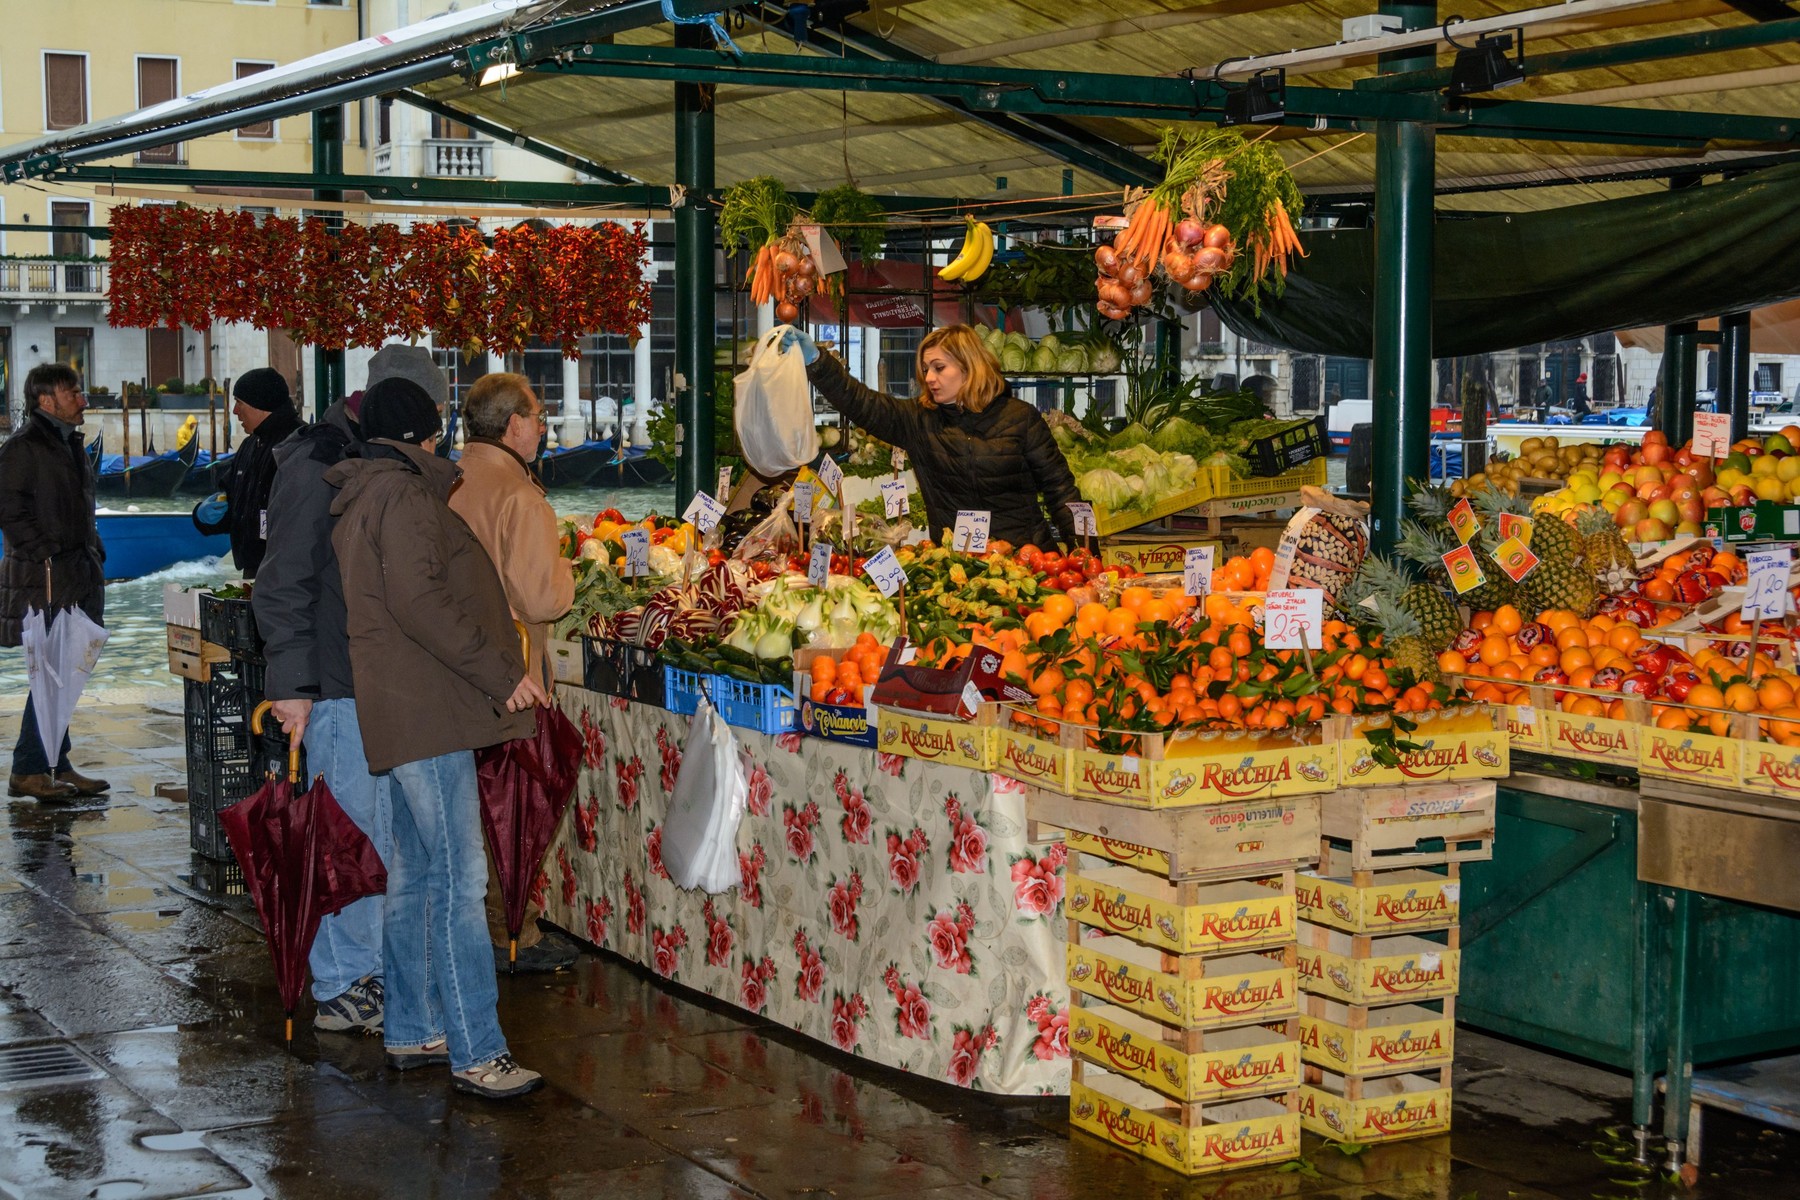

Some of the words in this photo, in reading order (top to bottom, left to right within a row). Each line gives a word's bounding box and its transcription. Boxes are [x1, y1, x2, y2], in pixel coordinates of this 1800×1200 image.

[898, 309, 920, 319] MOSTRA
[1231, 496, 1286, 510] Checchin
[814, 707, 868, 736] Terranova
[900, 721, 955, 758] RECCHIA
[1557, 719, 1628, 753] RECCHIA
[1004, 738, 1057, 776] RECCHIA
[1649, 736, 1725, 773] RECCHIA
[1082, 760, 1141, 794] RECCHIA
[1199, 756, 1292, 796] RECCHIA
[1209, 812, 1245, 826] GROUP
[1246, 807, 1283, 821] MILELLA
[1092, 888, 1153, 932] RECCHIA
[1199, 905, 1282, 941] RECCHIA
[1373, 889, 1447, 922] RECCHIA
[1093, 958, 1154, 1003] RECCHIA
[1370, 959, 1445, 993] RECCHIA
[1202, 977, 1284, 1014] RECCHIA
[1095, 1023, 1157, 1072] RECCHIA
[1367, 1028, 1441, 1063] RECCHIA
[1203, 1051, 1286, 1088] RECCHIA
[1096, 1098, 1157, 1146] RECCHIA
[1362, 1098, 1437, 1134] RECCHIA
[1202, 1123, 1284, 1161] RECCHIA
